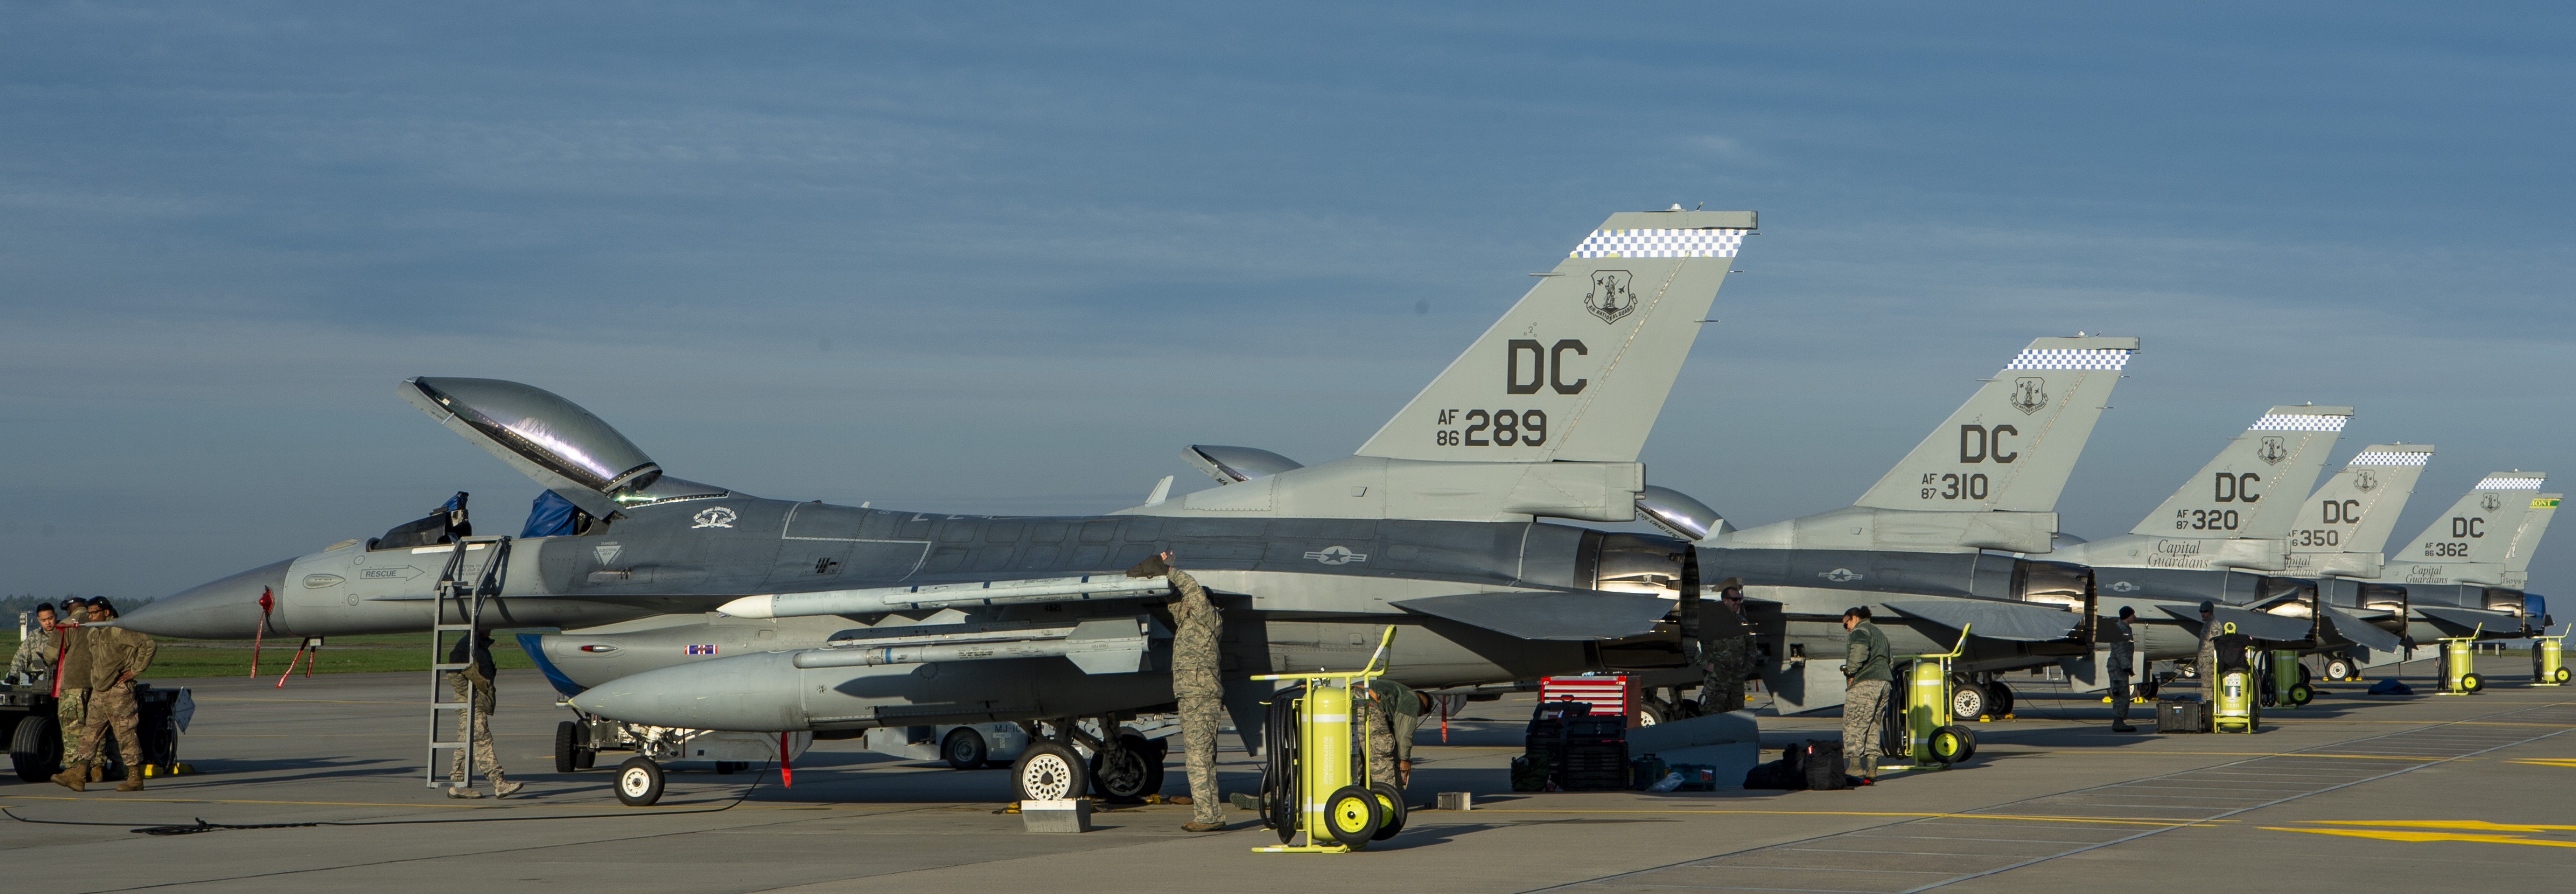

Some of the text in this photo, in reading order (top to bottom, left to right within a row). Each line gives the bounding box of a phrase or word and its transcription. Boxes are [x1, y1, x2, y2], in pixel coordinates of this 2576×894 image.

[1596, 310, 1618, 321] NATIONAL
[1619, 305, 1633, 316] GUARD
[1507, 339, 1588, 395] DC
[1437, 409, 1459, 425] AF
[1465, 409, 1547, 446] 289
[1437, 430, 1459, 446] 86
[1961, 424, 2018, 463] DC
[1922, 473, 1937, 485] AF
[1941, 473, 1988, 500] 310
[2216, 472, 2260, 502] DC
[1921, 488, 1937, 500] 87
[2176, 509, 2189, 518] AF
[2192, 509, 2238, 530] 320
[2323, 500, 2360, 523] DC
[2176, 521, 2189, 529] 87
[2452, 517, 2484, 538] DC
[2300, 530, 2339, 546] 350
[2158, 539, 2201, 557] Capital
[2436, 543, 2468, 557] 362
[2148, 553, 2209, 568] Guardians
[2406, 574, 2448, 584] Guardians
[2412, 565, 2442, 578] Capital
[2502, 577, 2522, 587] Boys
